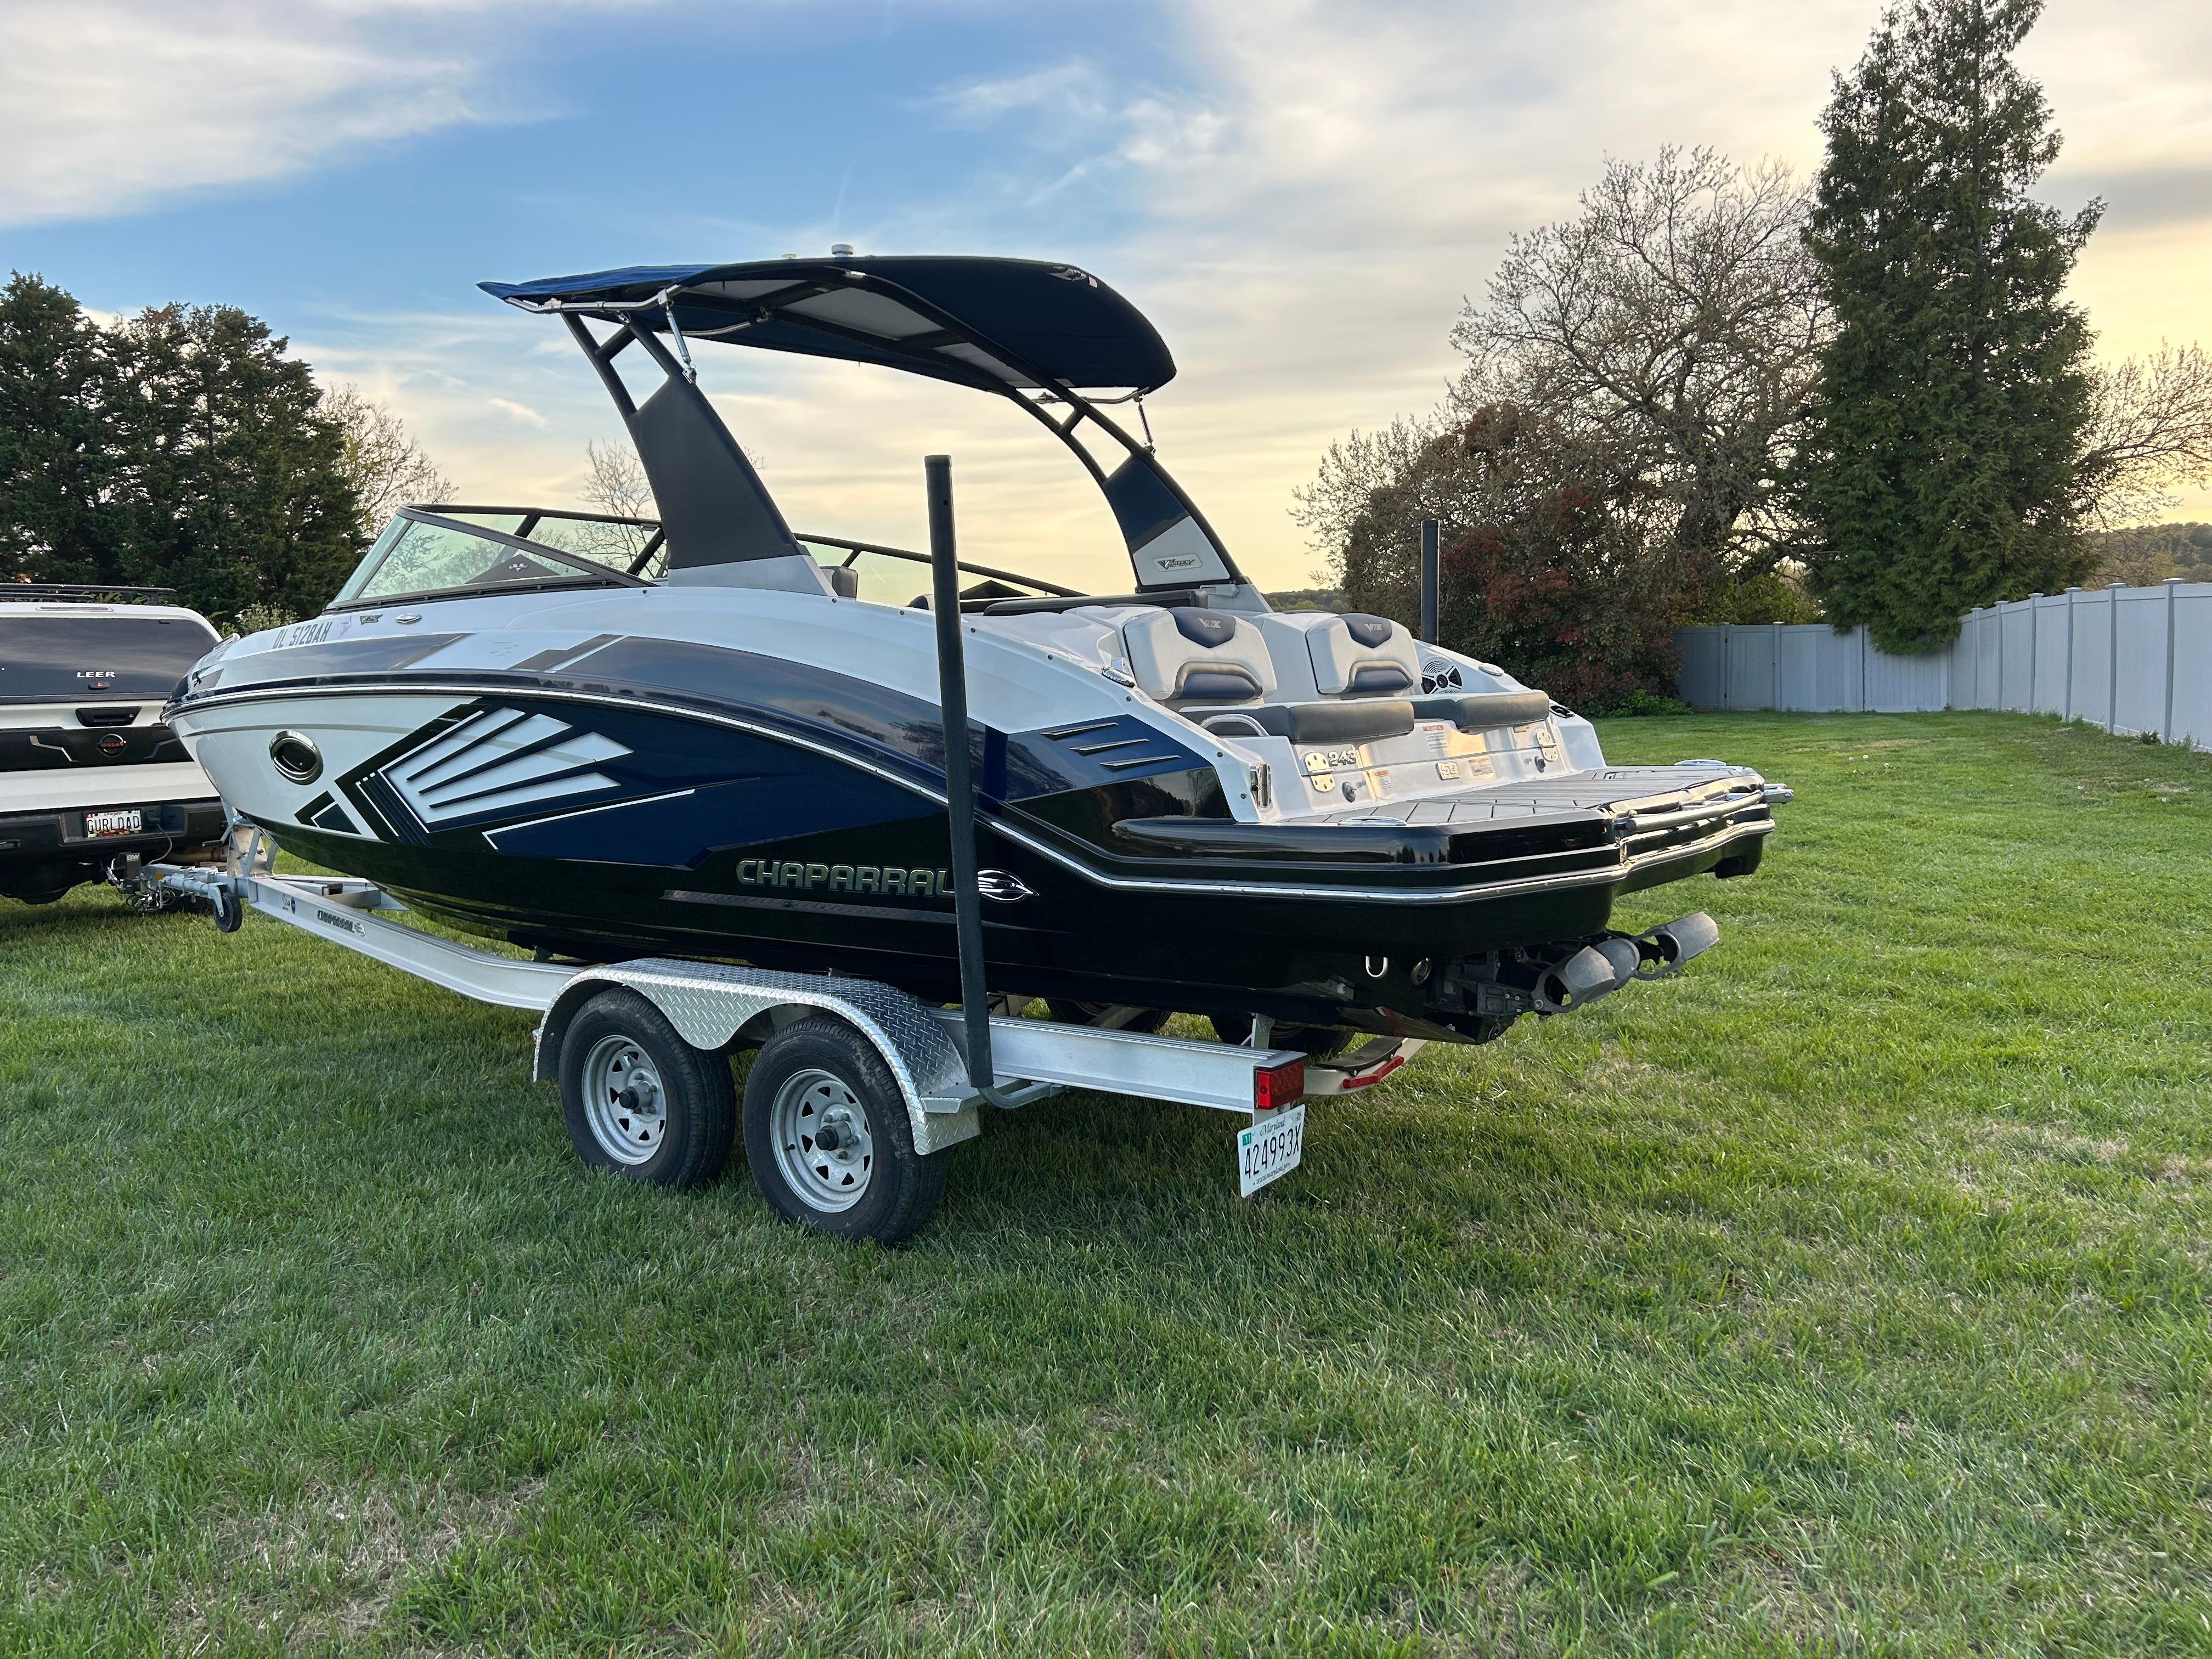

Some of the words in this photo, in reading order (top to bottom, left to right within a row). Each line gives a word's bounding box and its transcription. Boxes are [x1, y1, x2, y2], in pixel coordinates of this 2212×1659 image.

[289, 621, 333, 647] 5128AH
[1328, 750, 1357, 767] 243
[736, 857, 956, 898] CHAPARRAL
[1260, 1115, 1286, 1136] Maryland
[1245, 1122, 1301, 1179] 424993X
